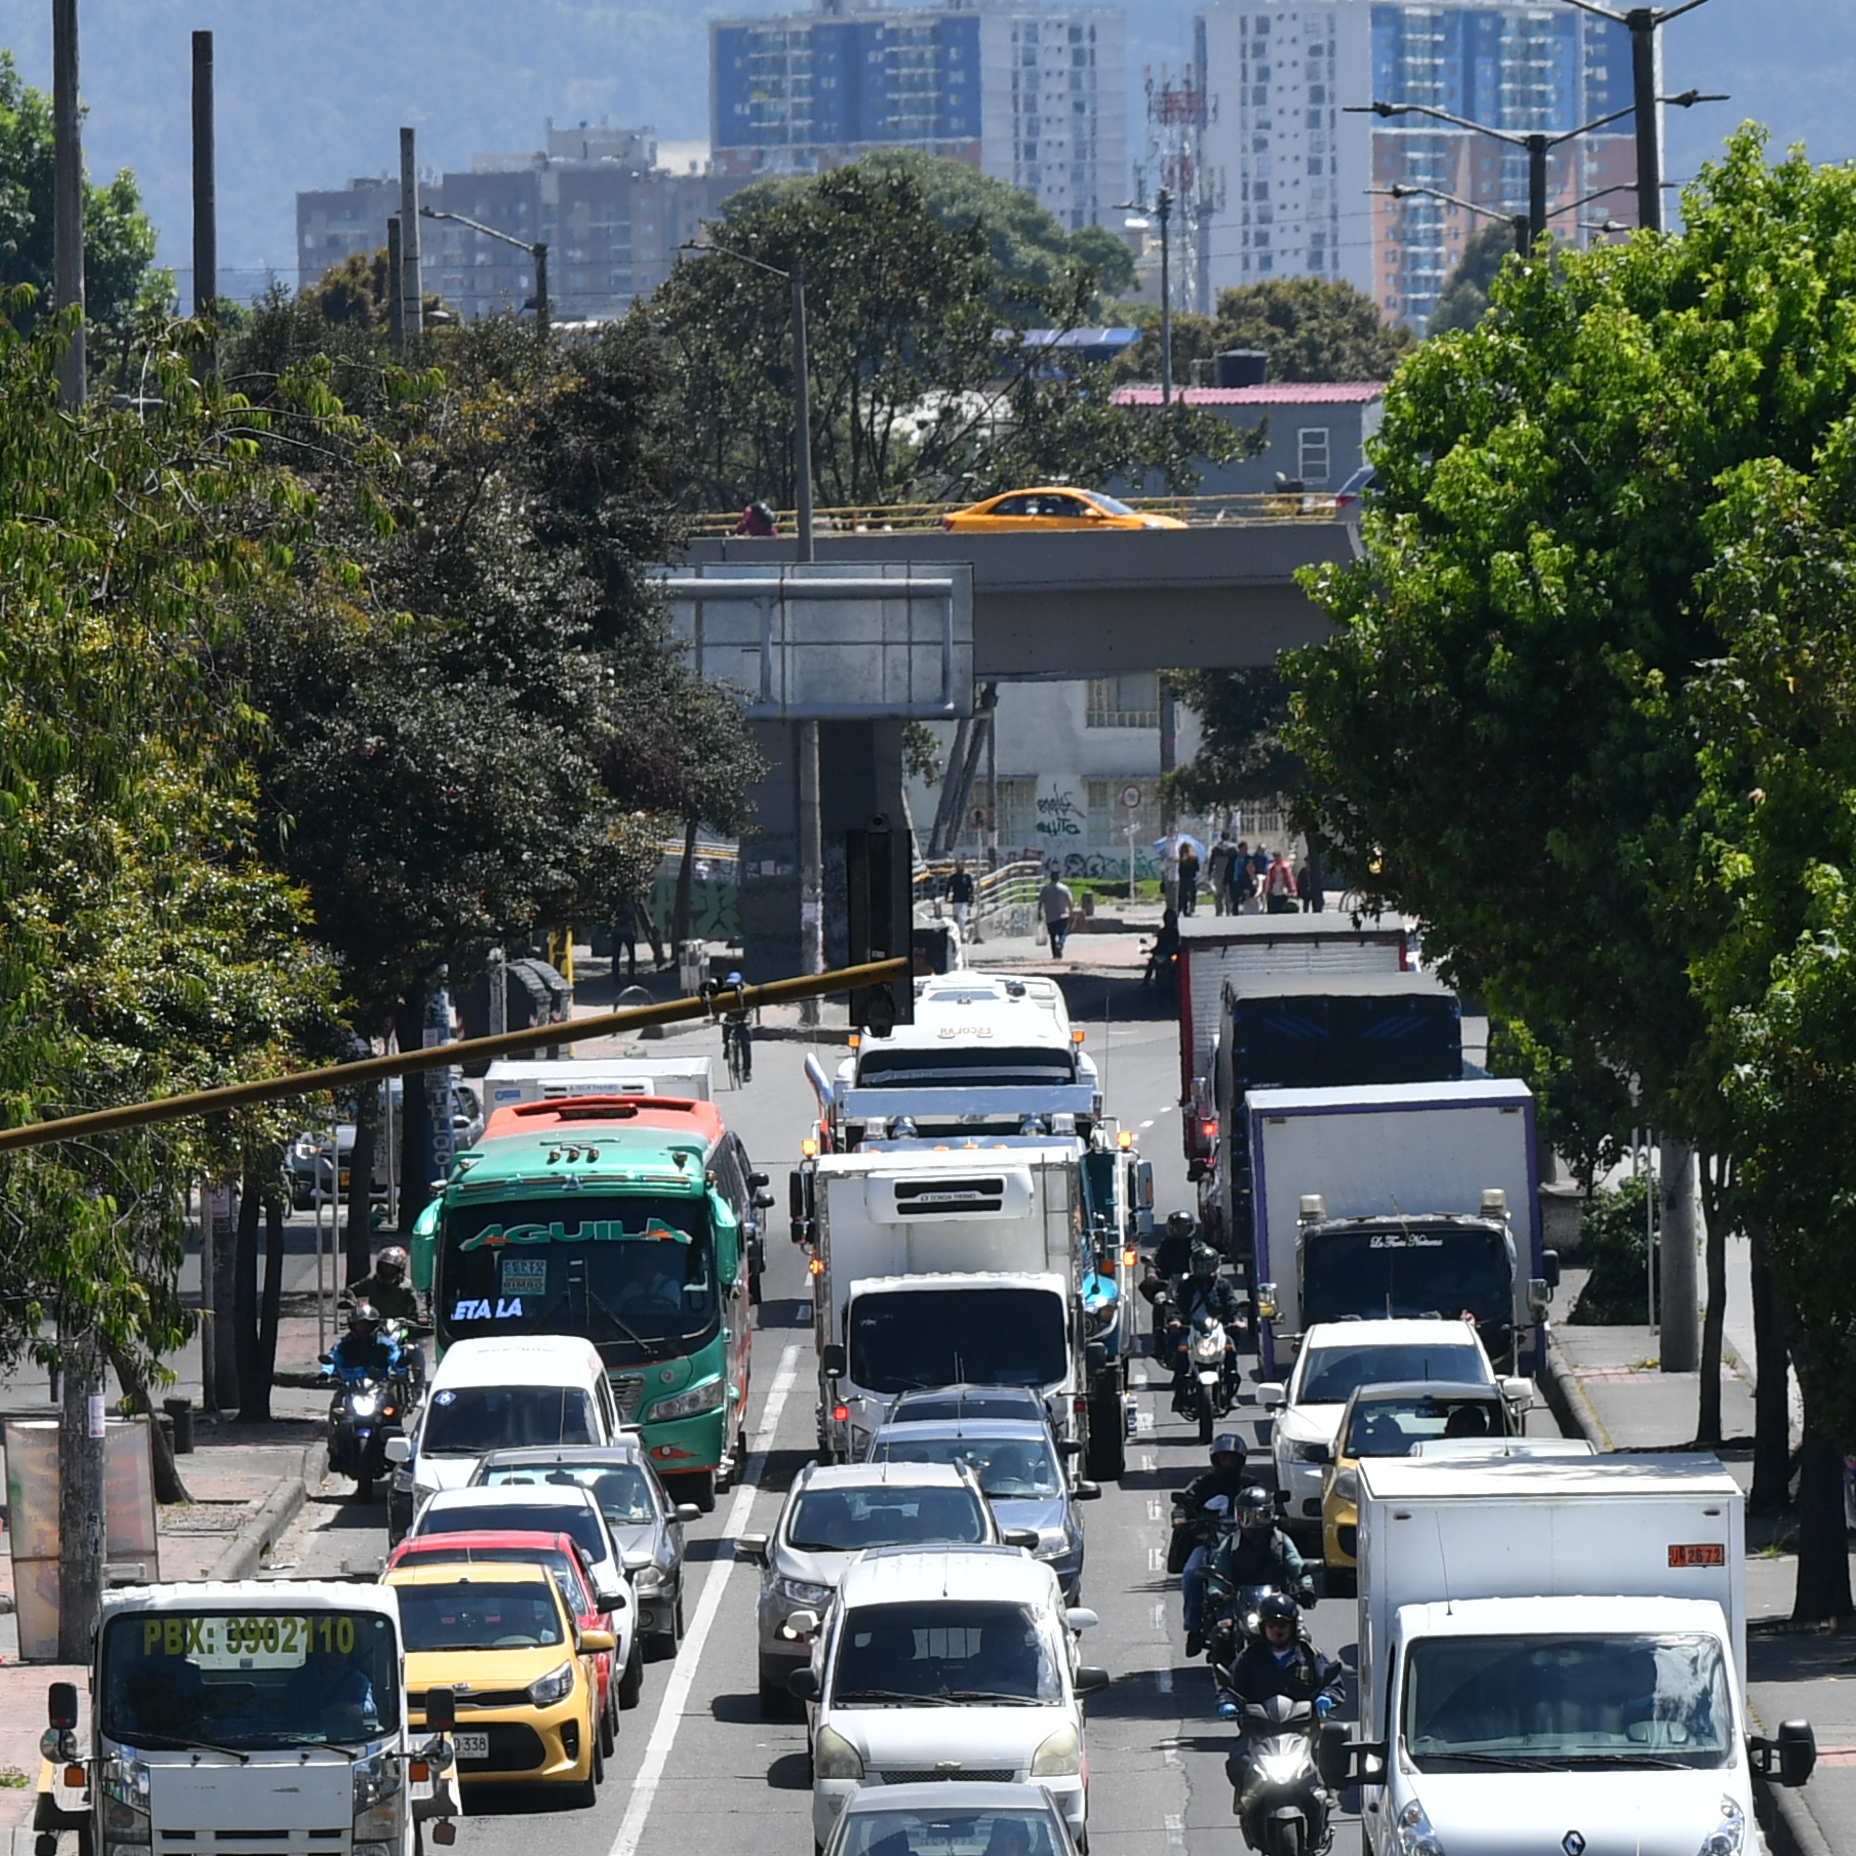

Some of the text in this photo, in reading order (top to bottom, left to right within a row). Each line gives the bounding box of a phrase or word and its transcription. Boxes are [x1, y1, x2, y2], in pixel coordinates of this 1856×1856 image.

[458, 1217, 694, 1252] AGUILA
[450, 1298, 492, 1321] ETA
[144, 1616, 355, 1655] PBX: 3902110
